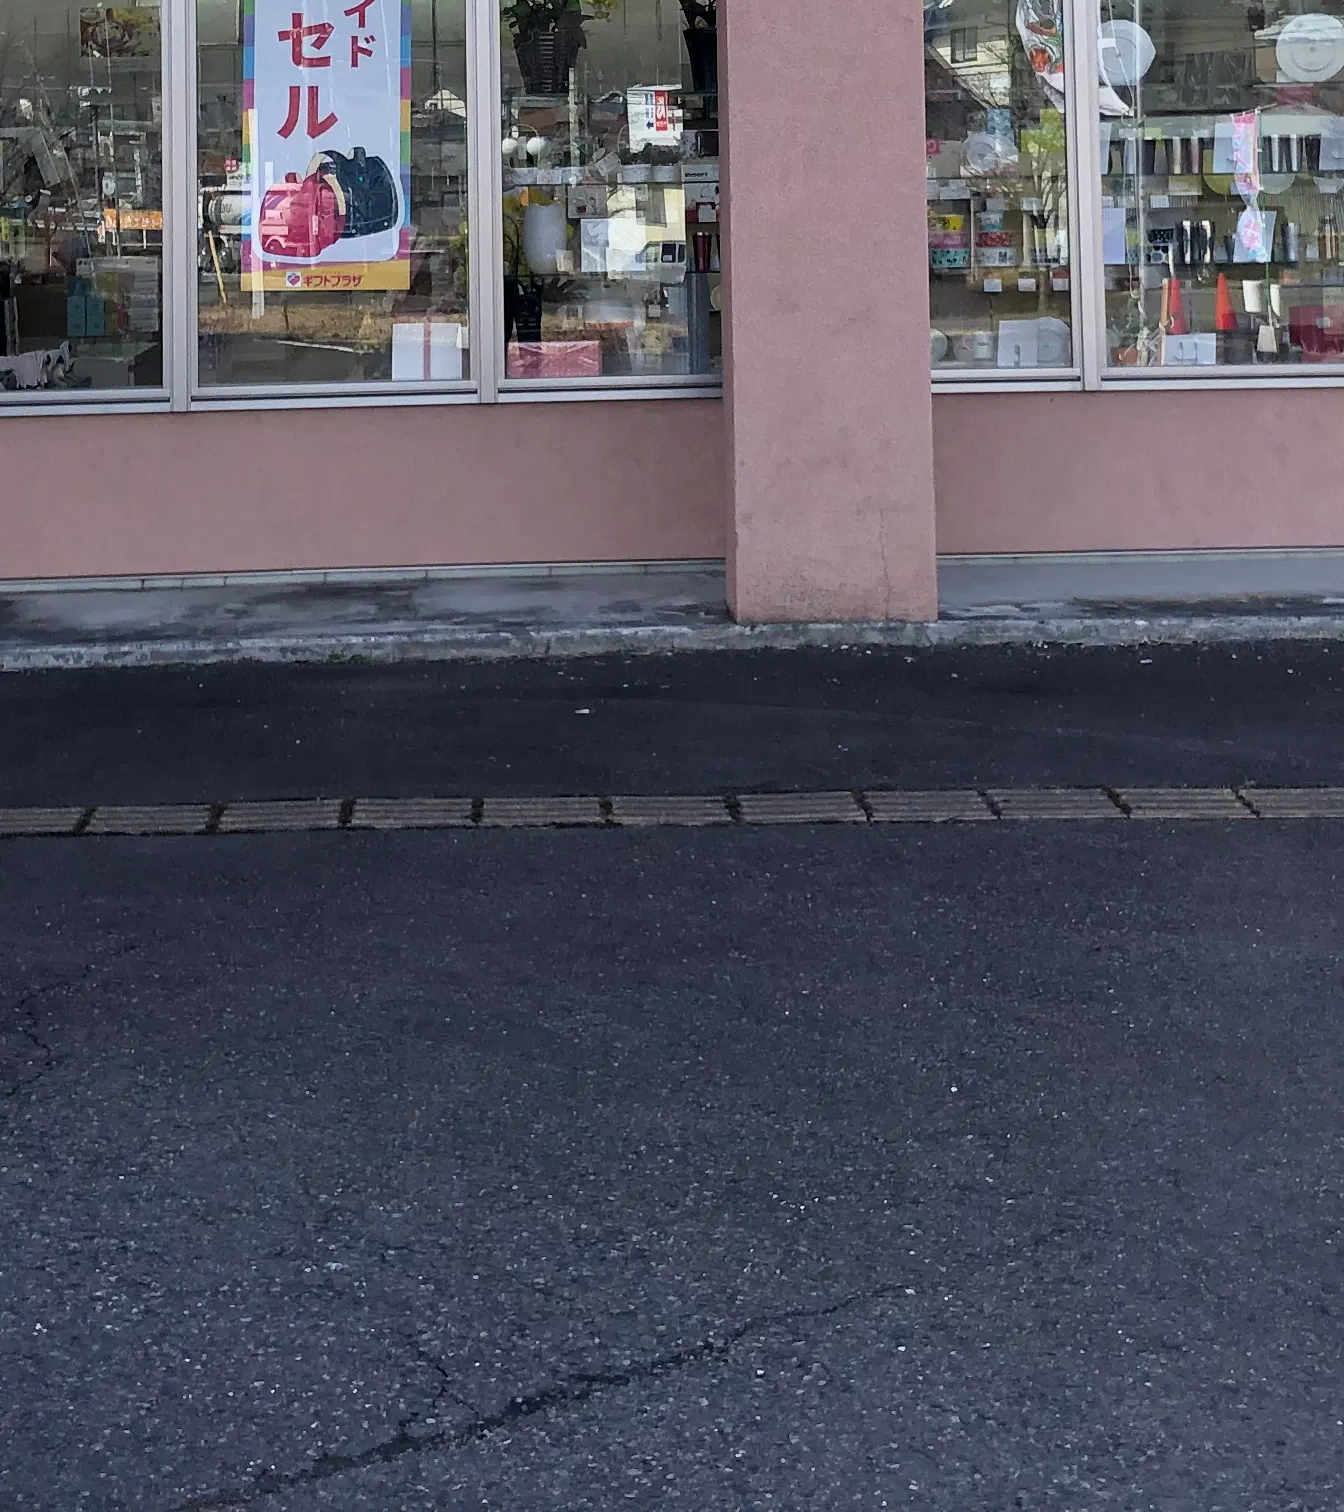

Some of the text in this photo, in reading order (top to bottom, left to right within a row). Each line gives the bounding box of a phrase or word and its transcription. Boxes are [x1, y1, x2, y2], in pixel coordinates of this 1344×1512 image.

[303, 274, 363, 289] ギフトプラザ
